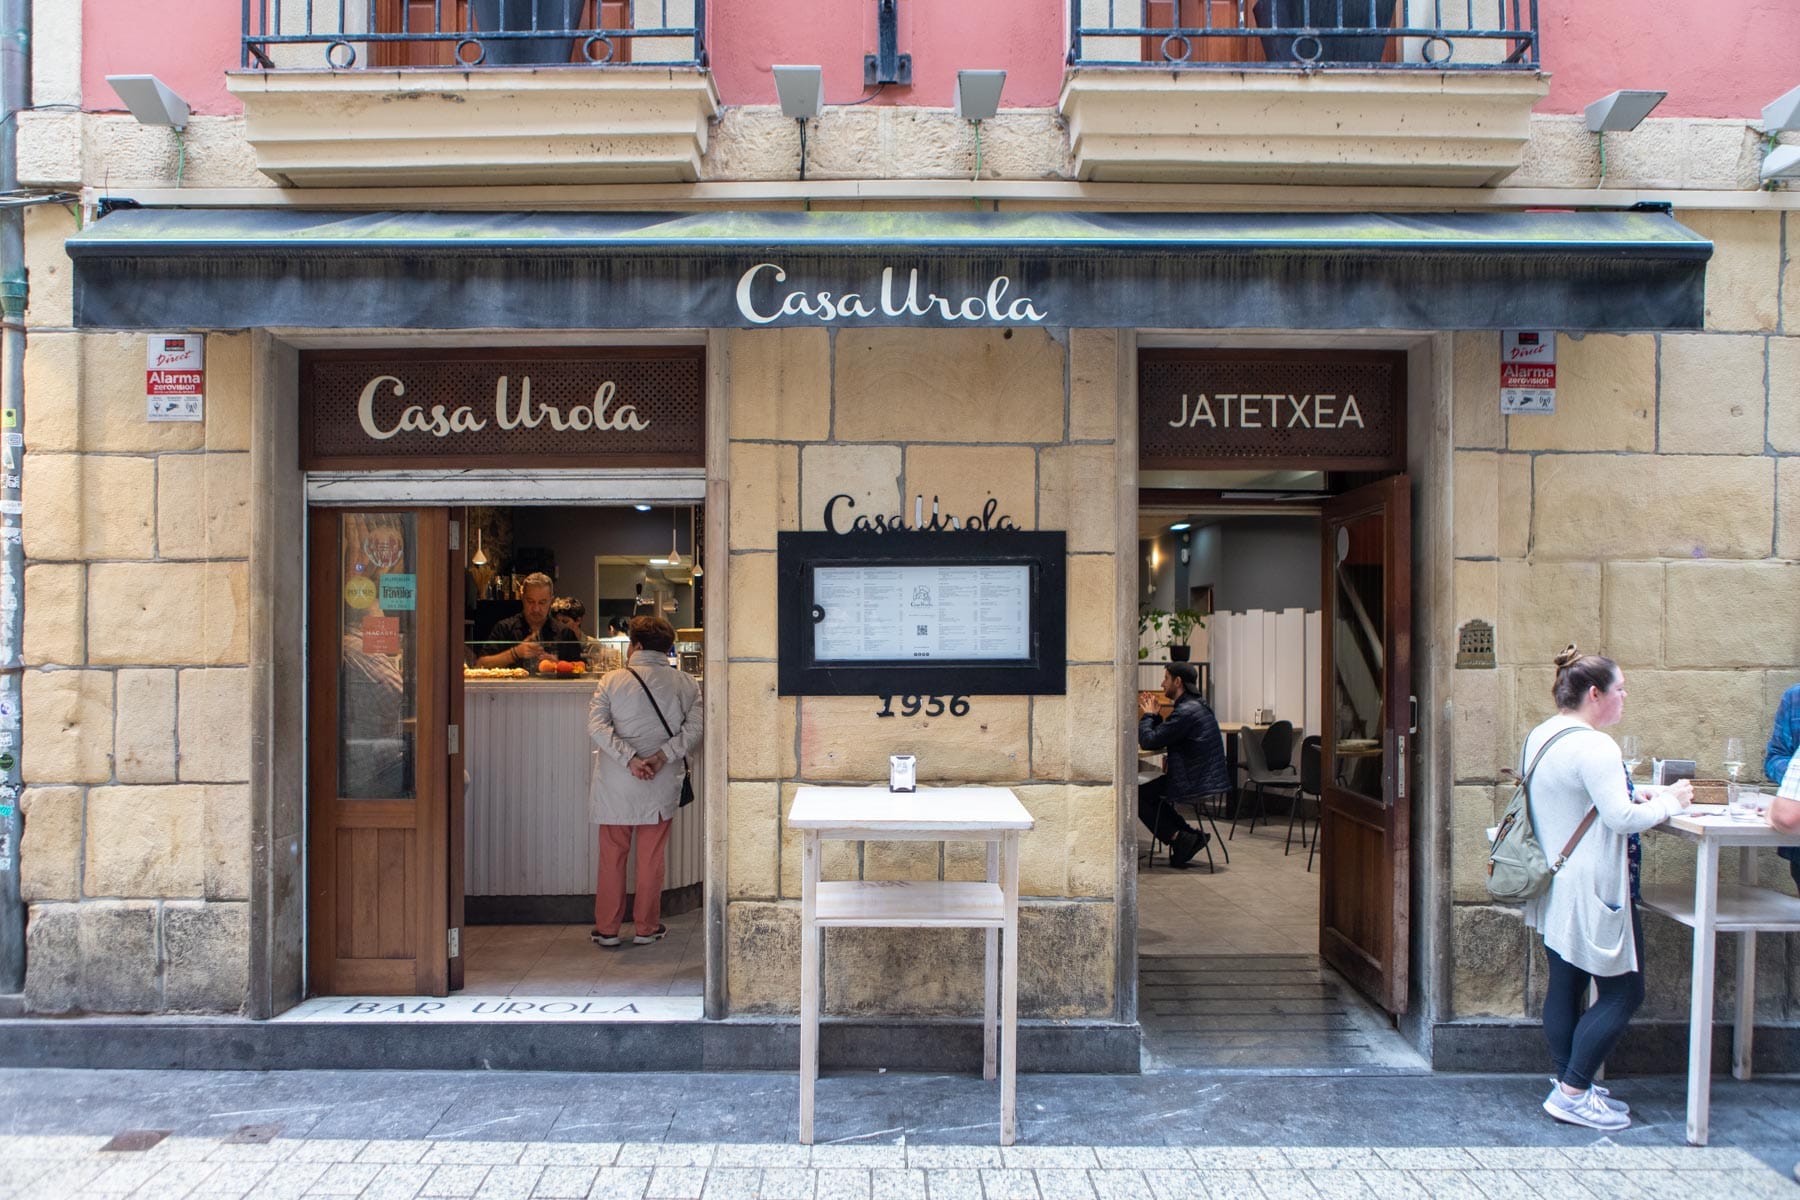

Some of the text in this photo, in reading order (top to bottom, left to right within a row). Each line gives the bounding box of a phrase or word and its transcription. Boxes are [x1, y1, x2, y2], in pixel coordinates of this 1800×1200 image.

[736, 263, 1047, 323] Casa Urola
[156, 350, 195, 366] Direct
[1510, 344, 1548, 360] Direct
[149, 371, 200, 384] Alarma
[1504, 364, 1553, 378] Alarma
[1508, 377, 1549, 385] zerovision
[358, 375, 650, 439] Casa Urola
[1168, 393, 1365, 429] JATETXEA
[824, 494, 1021, 535] Casa Urola
[876, 691, 970, 718] 1956
[344, 1002, 640, 1014] BAR UROLA
